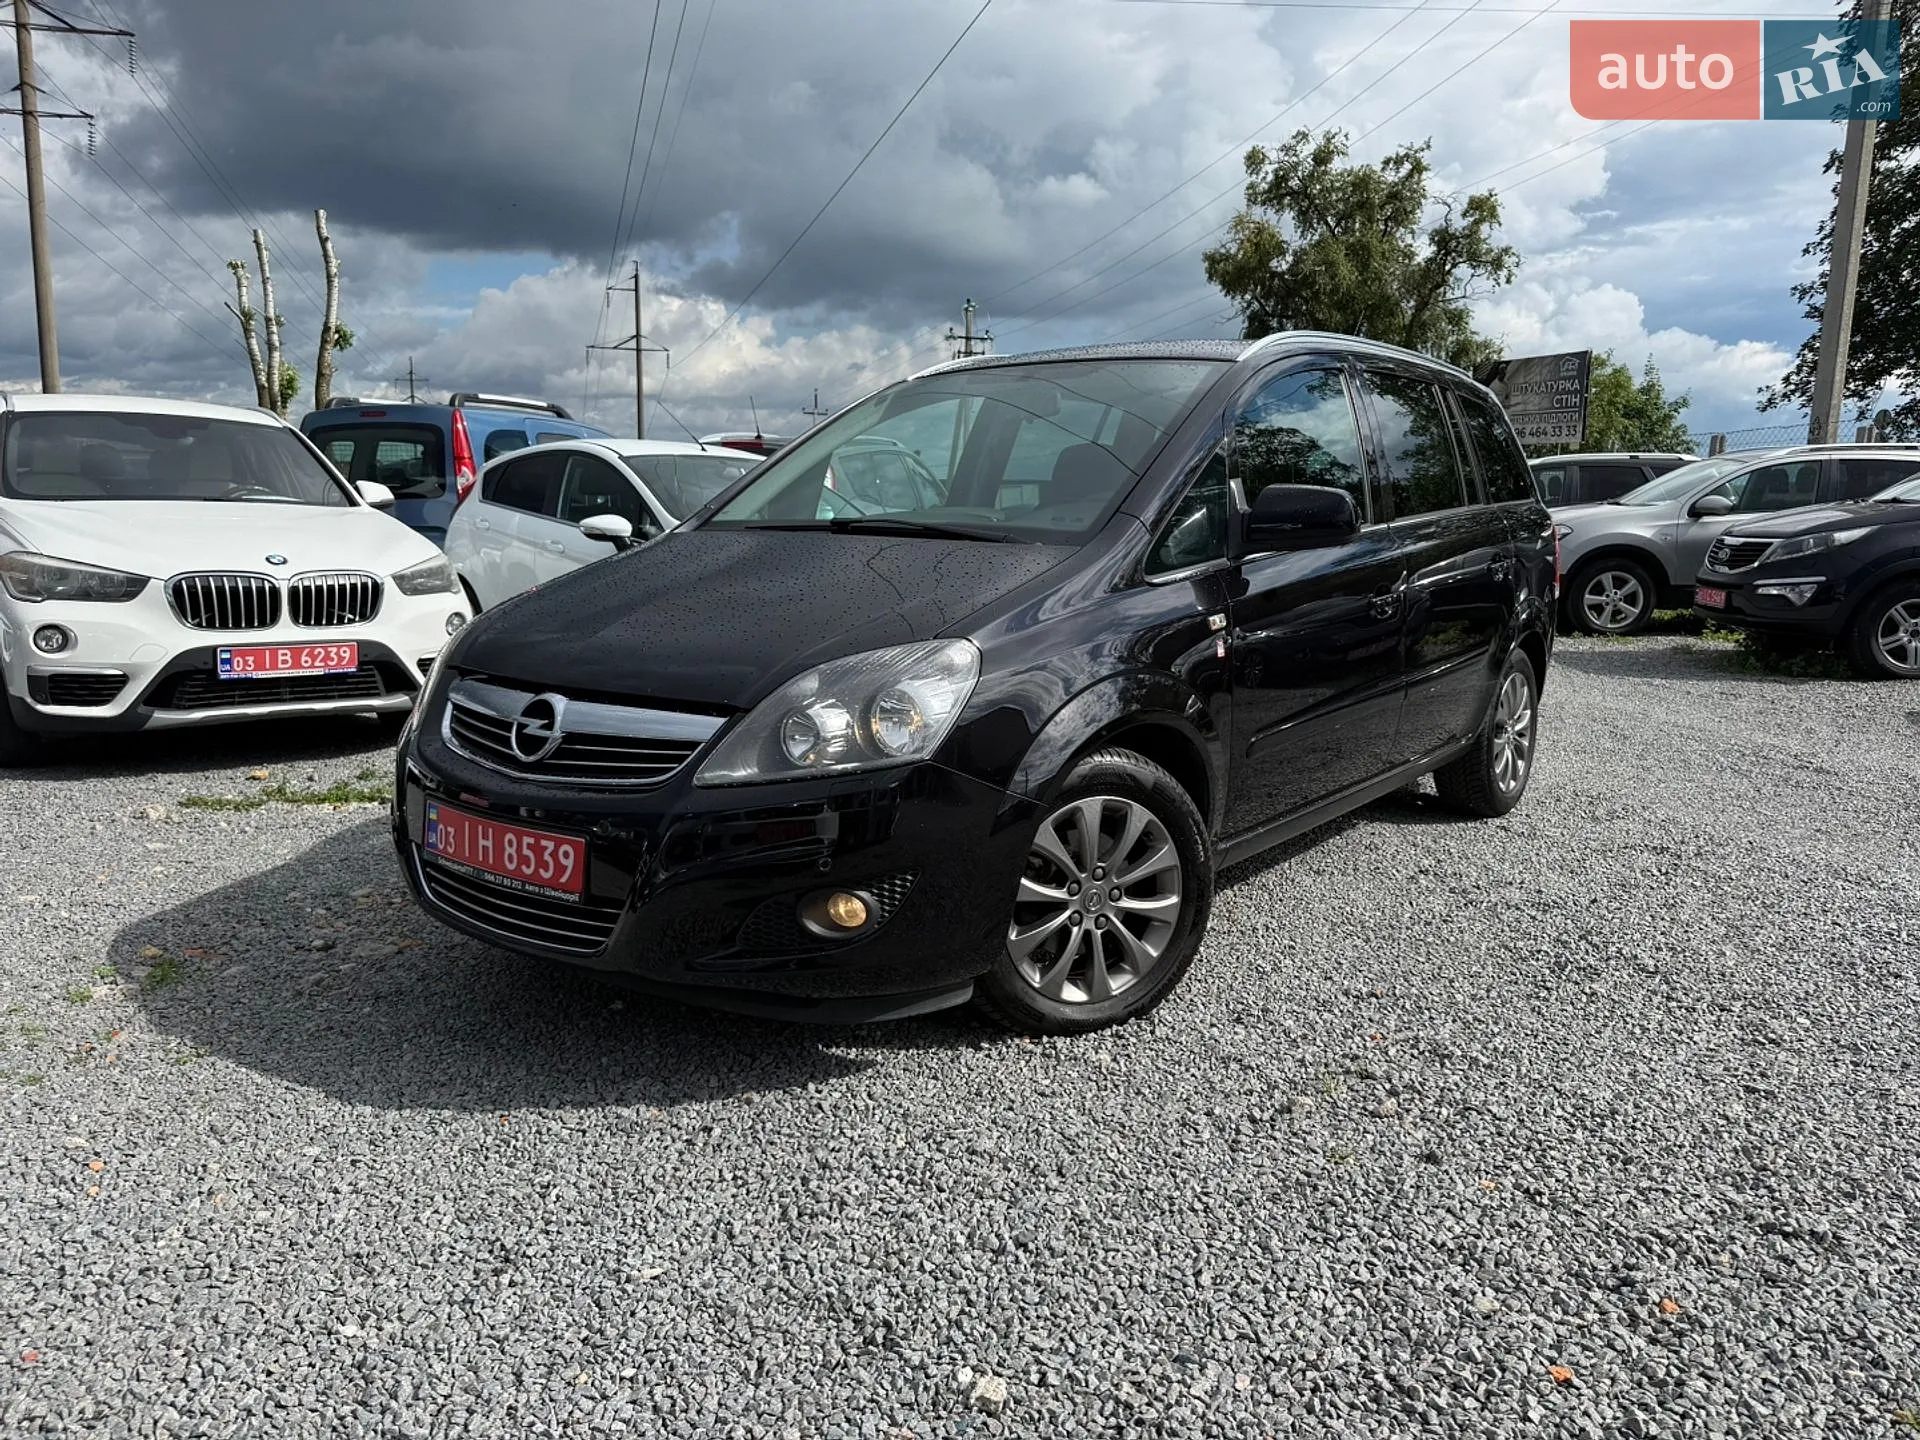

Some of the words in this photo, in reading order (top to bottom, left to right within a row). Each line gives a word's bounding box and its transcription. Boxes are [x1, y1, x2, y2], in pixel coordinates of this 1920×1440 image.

[1512, 379, 1580, 394] ШТУКАТУРКА
[1553, 394, 1580, 408] СТІН
[1528, 426, 1548, 438] 464
[1550, 426, 1562, 437] 33
[1565, 425, 1577, 437] 33
[233, 655, 255, 671] 03
[300, 646, 351, 667] 6239
[437, 823, 456, 854] 03
[503, 832, 575, 883] 8539
